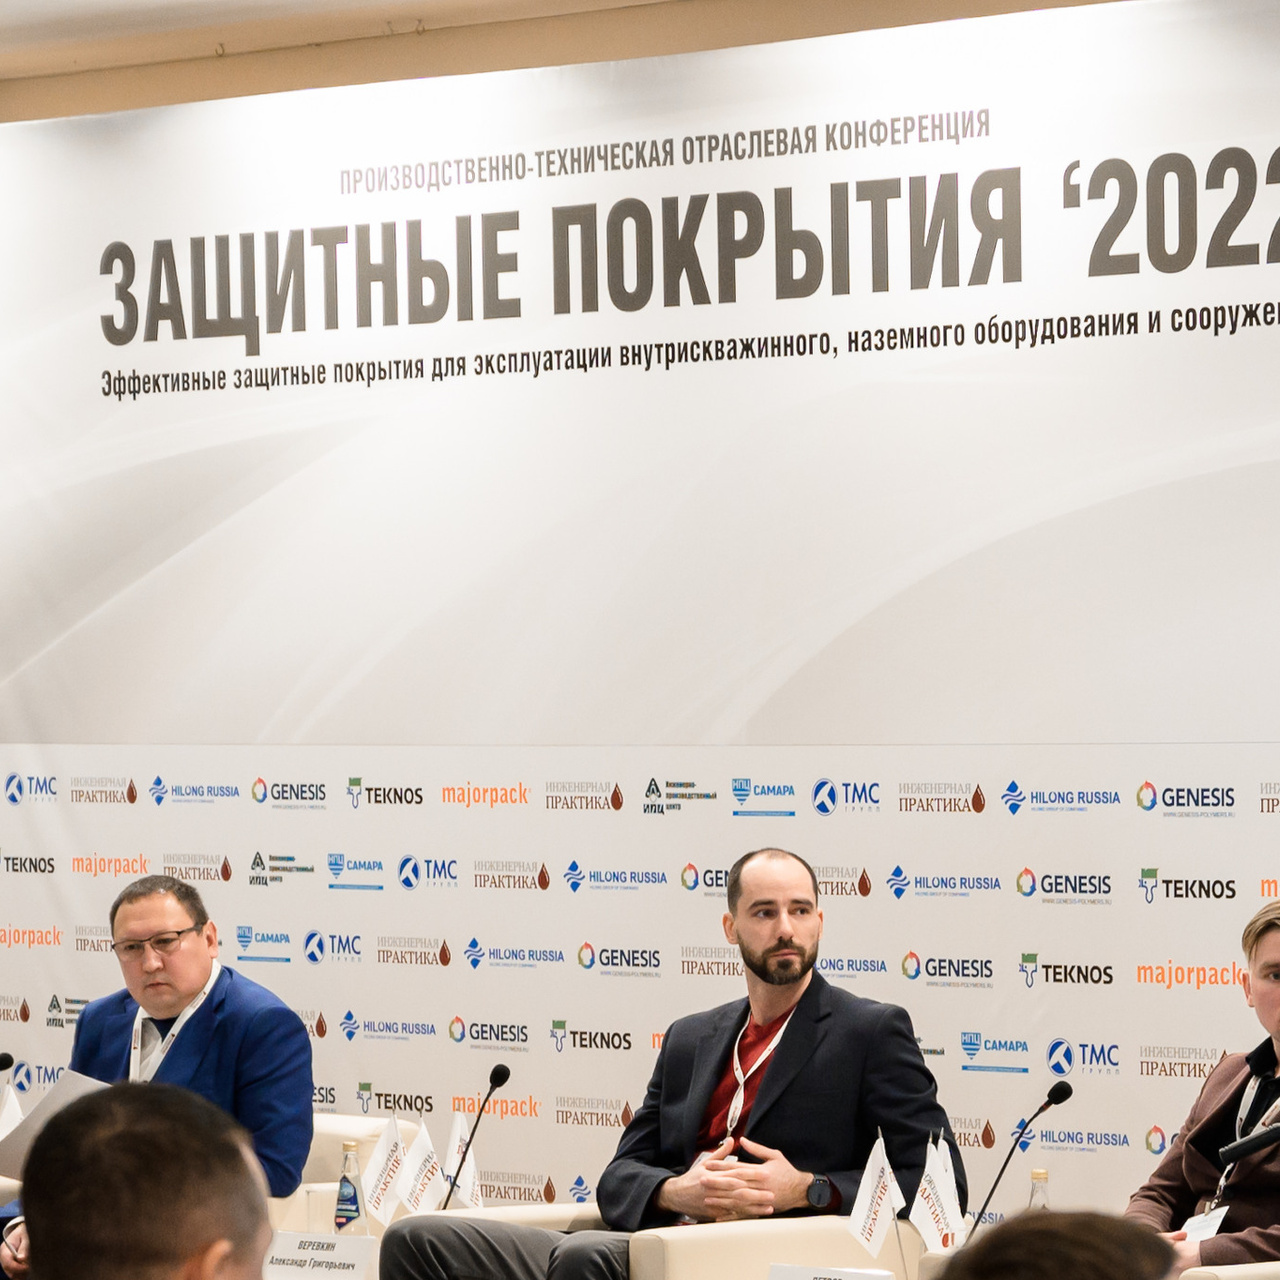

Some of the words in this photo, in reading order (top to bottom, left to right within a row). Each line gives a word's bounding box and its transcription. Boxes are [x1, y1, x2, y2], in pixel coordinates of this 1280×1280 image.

[340, 137, 675, 195] ПРОИЗВОДСТВЕННО-ТЕХНИЧЕСКАЯ
[681, 124, 817, 165] ОТРАСЛЕВАЯ
[825, 107, 990, 152] КОНФЕРЕНЦИЯ
[99, 209, 522, 357] ЗАЩИТНЫЕ
[551, 165, 1023, 315] ПОКРЫТИЯ
[101, 369, 227, 402] Эффективные
[233, 363, 327, 391] защитные
[333, 357, 425, 388] покрытия
[431, 354, 467, 382] для
[473, 345, 613, 379] эксплуатации
[619, 330, 840, 371] внутрискважинного,
[847, 322, 966, 354] наземного
[973, 310, 1140, 350] оборудования
[1147, 312, 1162, 334] и
[171, 785, 204, 797] HILONG
[206, 786, 240, 798] RUSSIA
[270, 783, 326, 800] GENESIS
[546, 781, 611, 793] ИНЖЕНЕРНАЯ
[732, 779, 750, 790] НПЦ
[754, 785, 795, 796] САМАРА
[898, 782, 972, 794] ИНЖЕНЕРНАЯ
[70, 790, 127, 803] ПРАКТИКА
[365, 787, 423, 805] TEKNOS
[442, 780, 528, 809] majorpack
[1030, 791, 1074, 804] HILONG
[1077, 792, 1121, 804] RUSSIA
[1162, 787, 1235, 808] GENESIS
[546, 795, 611, 810] ПРАКТИКА
[643, 804, 665, 816] ИПЦ
[899, 798, 972, 812] ПРАКТИКА
[4, 856, 55, 874] TEKNOS
[72, 852, 148, 878] majorpack
[162, 854, 220, 865] ИНЖЕНЕРНАЯ
[328, 854, 344, 864] НПЦ
[346, 860, 384, 872] САМАРА
[474, 860, 538, 872] ИНЖЕНЕРНАЯ
[163, 866, 220, 880] ПРАКТИКА
[589, 870, 627, 883] HILONG
[630, 871, 668, 884] RUSSIA
[814, 866, 858, 880] ЕНЕРНАЯ
[249, 876, 268, 886] ИПЦ
[474, 874, 538, 890] ПРАКТИКА
[817, 881, 858, 896] КТИКА
[914, 876, 956, 889] HILONG
[960, 876, 1002, 890] RUSSIA
[1041, 874, 1112, 894] GENESIS
[1162, 878, 1236, 900] TEKNOS
[0, 924, 62, 949] ajorpack
[75, 926, 111, 938] ИНЖЕНЕ
[236, 926, 252, 937] НПЦ
[254, 932, 290, 944] САМАРА
[76, 938, 114, 952] ПРАКТ
[377, 936, 439, 949] ИНЖЕНЕРНАЯ
[377, 950, 439, 966] ПРАКТИКА
[488, 948, 526, 961] HILONG
[528, 950, 564, 962] RUSSIA
[599, 948, 660, 968] GENESIS
[681, 946, 741, 960] ИНЖЕНЕРНА
[815, 958, 844, 972] LONG
[847, 959, 887, 972] RUSSIA
[925, 958, 992, 978] GENESIS
[1042, 964, 1114, 984] TEKNOS
[1136, 960, 1243, 990] majorpack
[363, 1020, 399, 1034] HILONG
[401, 1022, 436, 1035] RUSSIA
[470, 1022, 528, 1042] GENESIS
[570, 1030, 632, 1050] TEKNOS
[962, 1032, 980, 1044] НПЦ
[984, 1040, 1028, 1052] САМАРА
[1140, 1046, 1217, 1060] ИНЖЕНЕРНАЯ
[1140, 1060, 1216, 1078] ПРАКТИКА
[312, 1086, 336, 1104] ESIS
[374, 1092, 434, 1112] TEKNOS
[452, 1092, 539, 1120] majorpack
[556, 1096, 621, 1110] ИНЖЕНЕРНАЯ
[556, 1110, 621, 1128] ПРАКТИКА
[1040, 1130, 1084, 1144] HILONG
[1086, 1132, 1130, 1147] RUSSIA
[372, 1154, 402, 1211] ПРАКТИК
[480, 1170, 544, 1185] ИНЖЕНЕРНАЯ
[412, 1161, 440, 1212] ПРАКТИ
[480, 1184, 543, 1202] ПРАКТИКА
[923, 1171, 950, 1230] НЖЕНЕРНАЯ
[864, 1180, 889, 1243] ПРАКТИК
[917, 1182, 944, 1238] АКТИКА
[969, 1210, 1005, 1224] USSIA
[298, 1240, 336, 1252] ВЕРЕВКИН
[268, 1256, 308, 1268] Александр
